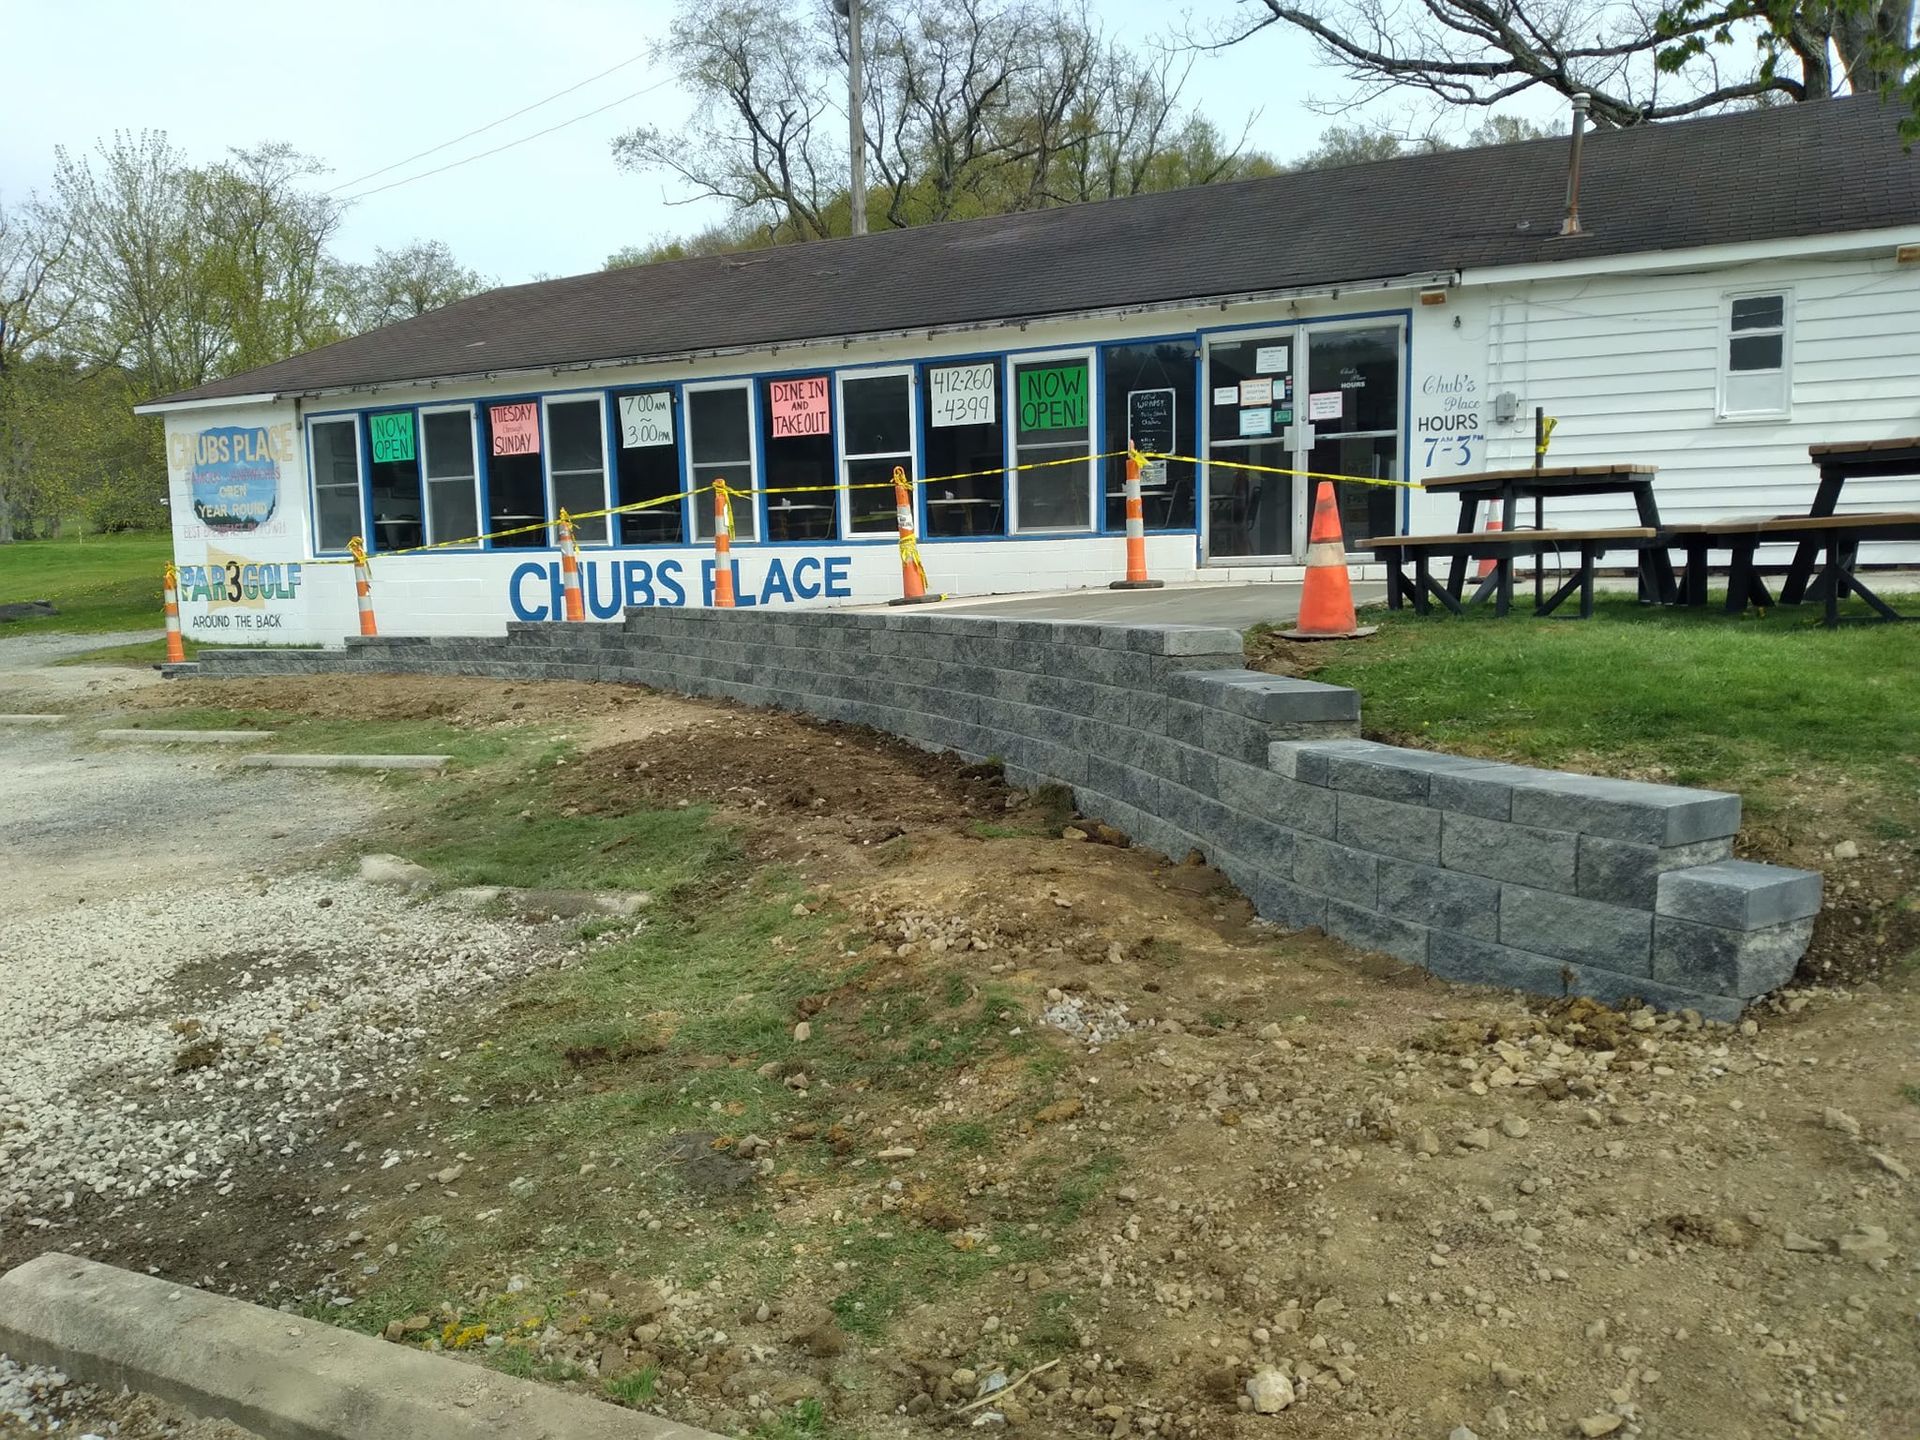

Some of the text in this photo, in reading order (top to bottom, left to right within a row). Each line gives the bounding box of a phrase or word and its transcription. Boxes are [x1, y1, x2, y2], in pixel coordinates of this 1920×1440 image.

[773, 380, 824, 403] DINE IN
[1028, 370, 1081, 400] NOW
[1341, 381, 1366, 389] HOURS
[1422, 374, 1476, 394] Chub's
[491, 404, 532, 423] TUESDAY
[791, 400, 809, 411] AND
[1022, 396, 1084, 428] OPEN!
[1444, 396, 1480, 411] Place
[375, 416, 407, 440] NOW
[1418, 413, 1478, 432] HOURS
[170, 423, 294, 470] CHUBS PLACE
[494, 433, 531, 455] SUNDAY
[198, 501, 268, 518] YEAR ROUND
[179, 560, 301, 602] PAR 3 GOLF
[192, 613, 282, 629] AROUND THE BACK
